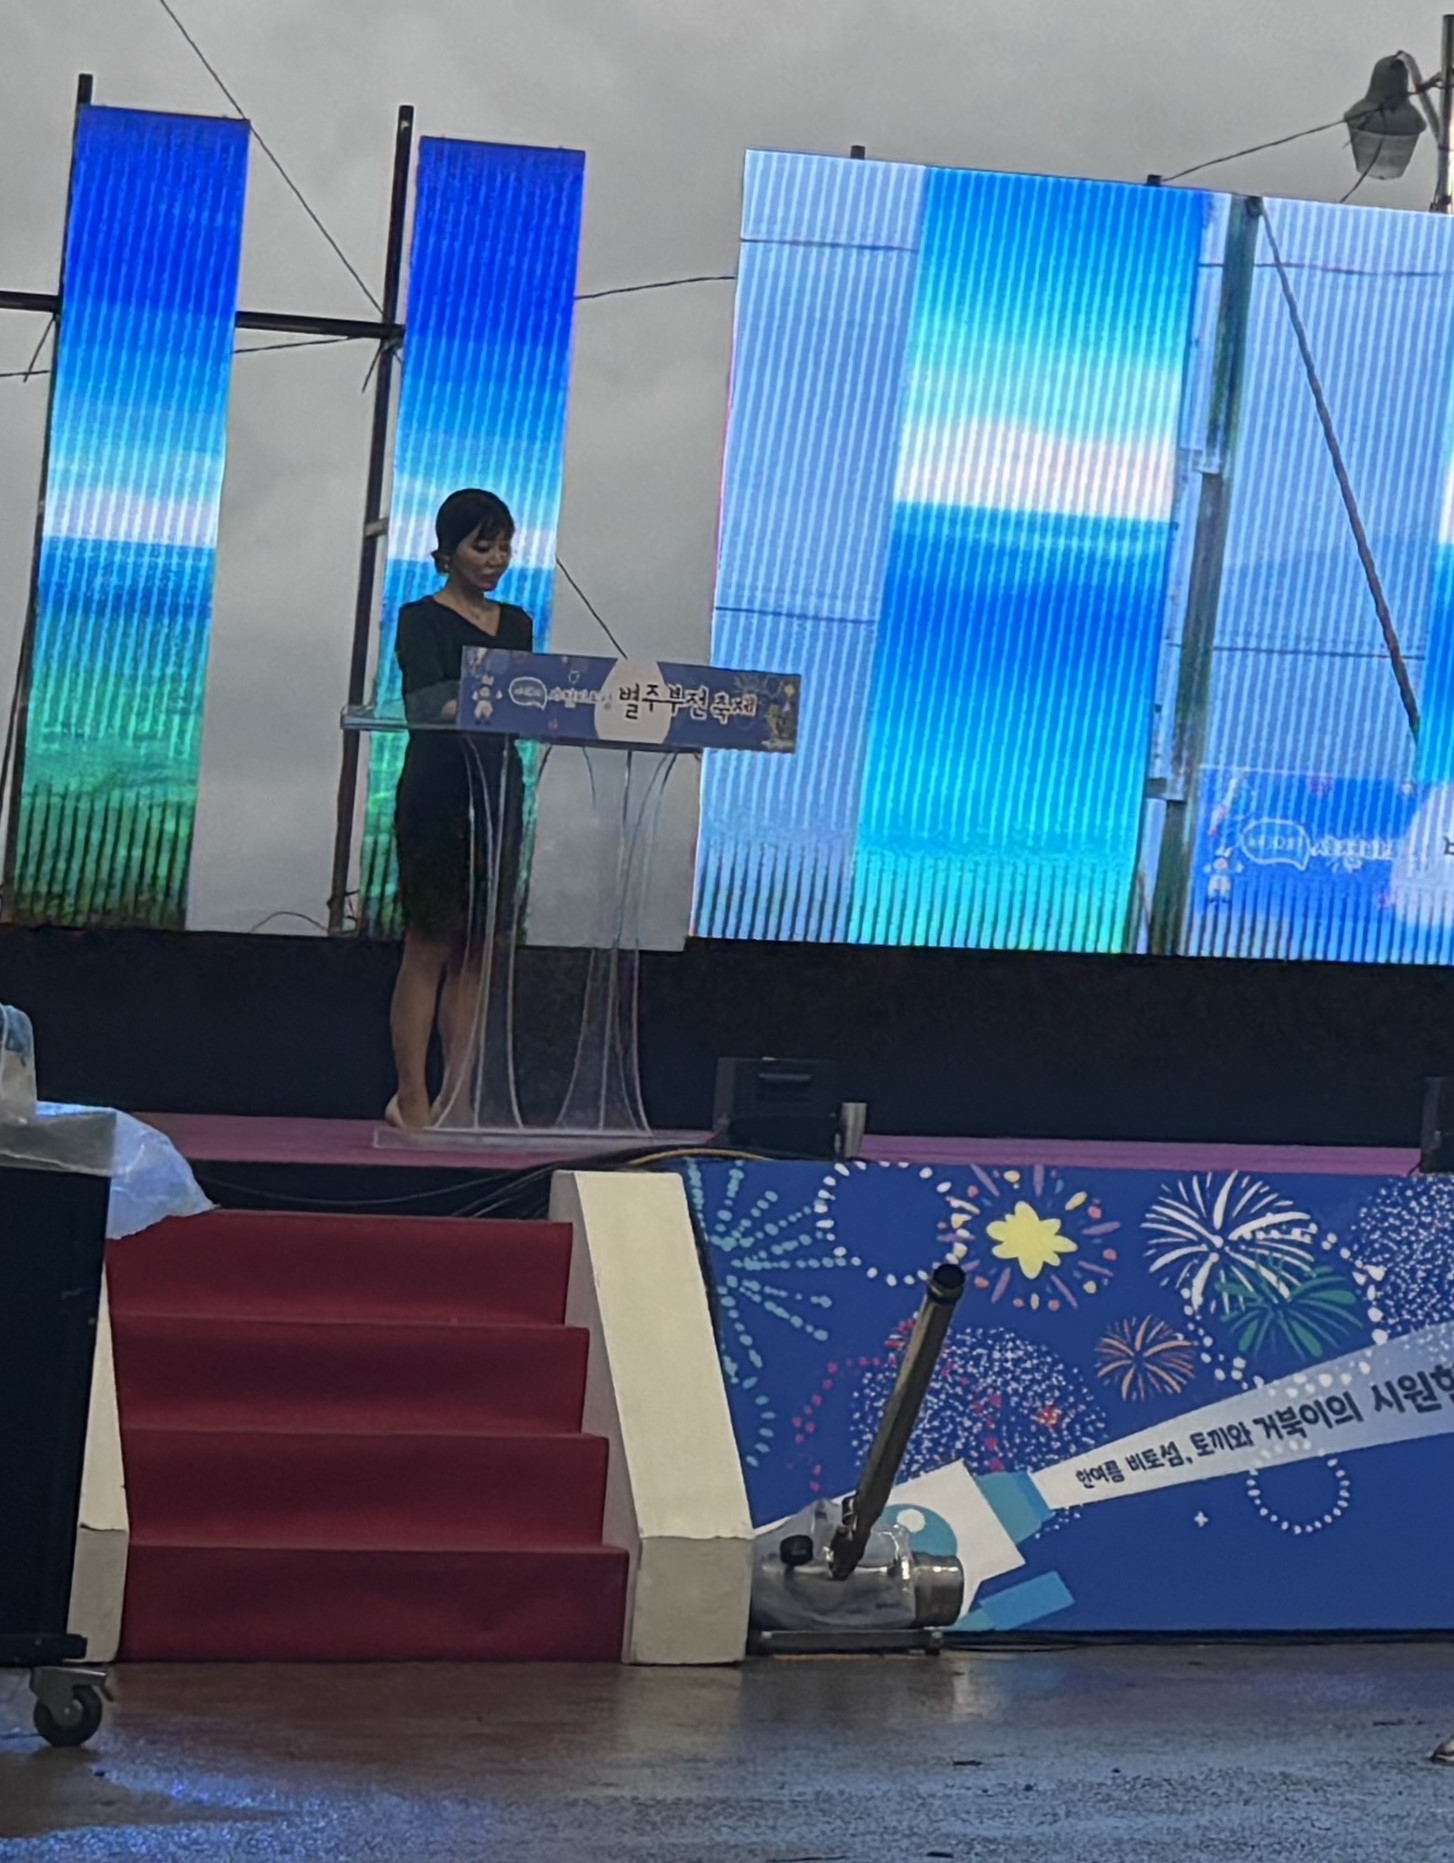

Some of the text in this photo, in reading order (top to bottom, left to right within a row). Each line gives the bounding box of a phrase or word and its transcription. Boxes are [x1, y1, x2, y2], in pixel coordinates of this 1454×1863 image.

[618, 681, 707, 721] 별주부전
[710, 692, 759, 726] 축제
[1075, 1459, 1126, 1490] 한여름
[1124, 1440, 1194, 1473] 비토섬,
[1188, 1420, 1256, 1458] 토끼와
[1251, 1390, 1365, 1440] 거북이의
